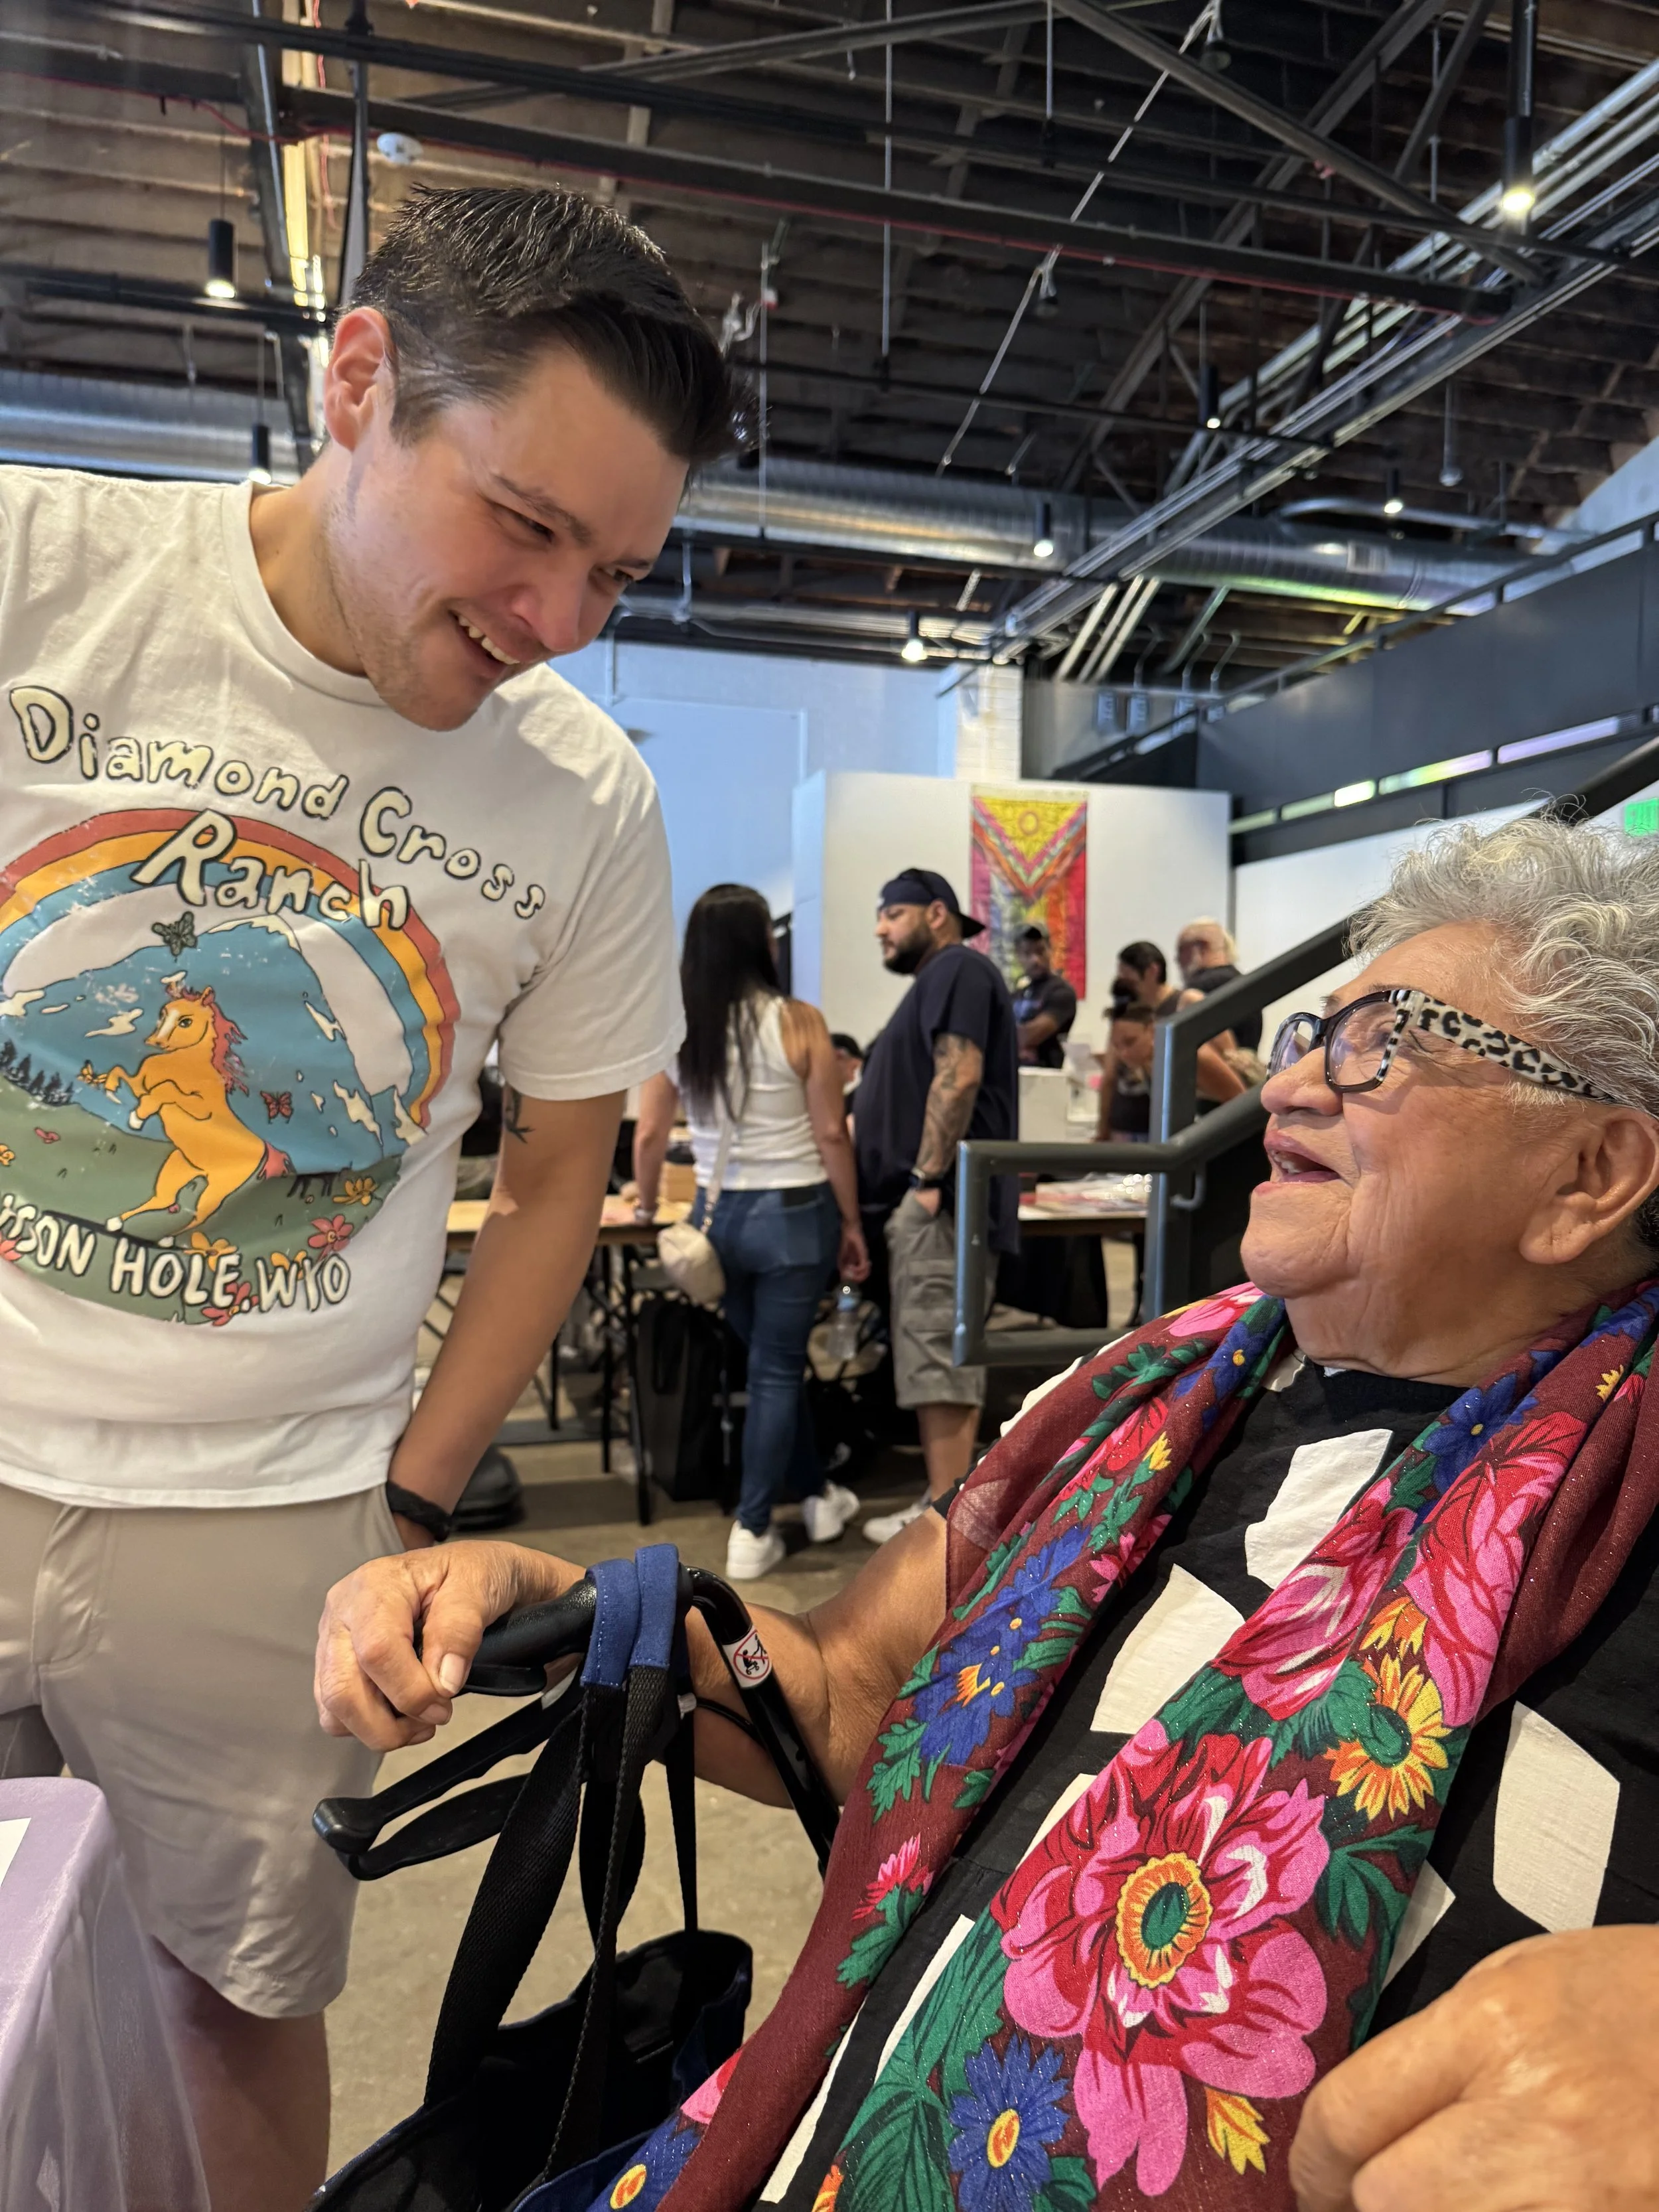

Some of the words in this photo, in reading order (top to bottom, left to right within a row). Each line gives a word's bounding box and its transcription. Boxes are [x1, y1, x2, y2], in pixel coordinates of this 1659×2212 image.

[10, 686, 348, 820] Diamond
[360, 787, 545, 919] Cross
[132, 809, 410, 930] Ranch
[255, 1253, 350, 1312] WYO
